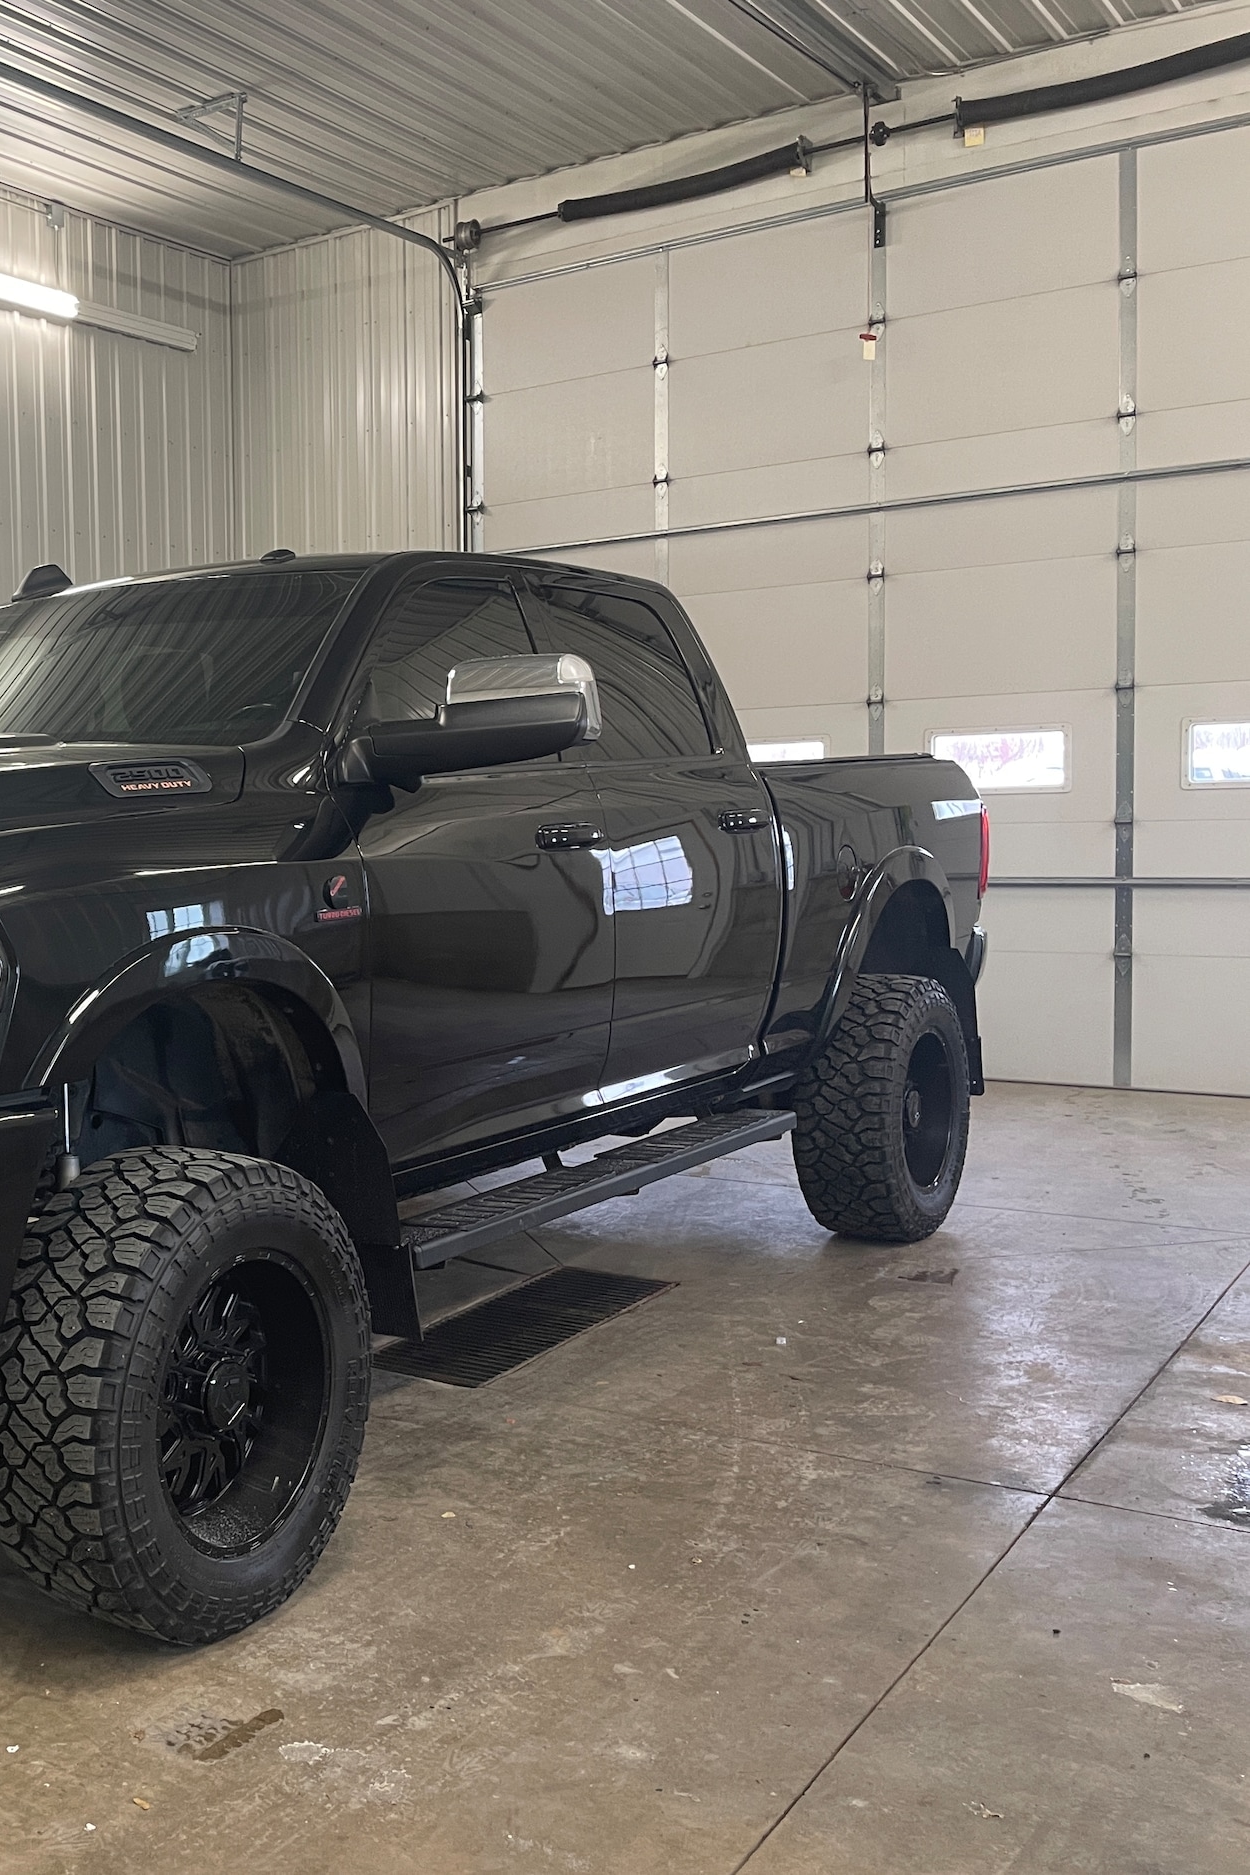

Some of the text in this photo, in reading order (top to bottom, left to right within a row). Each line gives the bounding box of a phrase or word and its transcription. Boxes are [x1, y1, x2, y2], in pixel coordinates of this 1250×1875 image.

[111, 768, 184, 783] 2500
[121, 780, 192, 791] HEAVY DUTY
